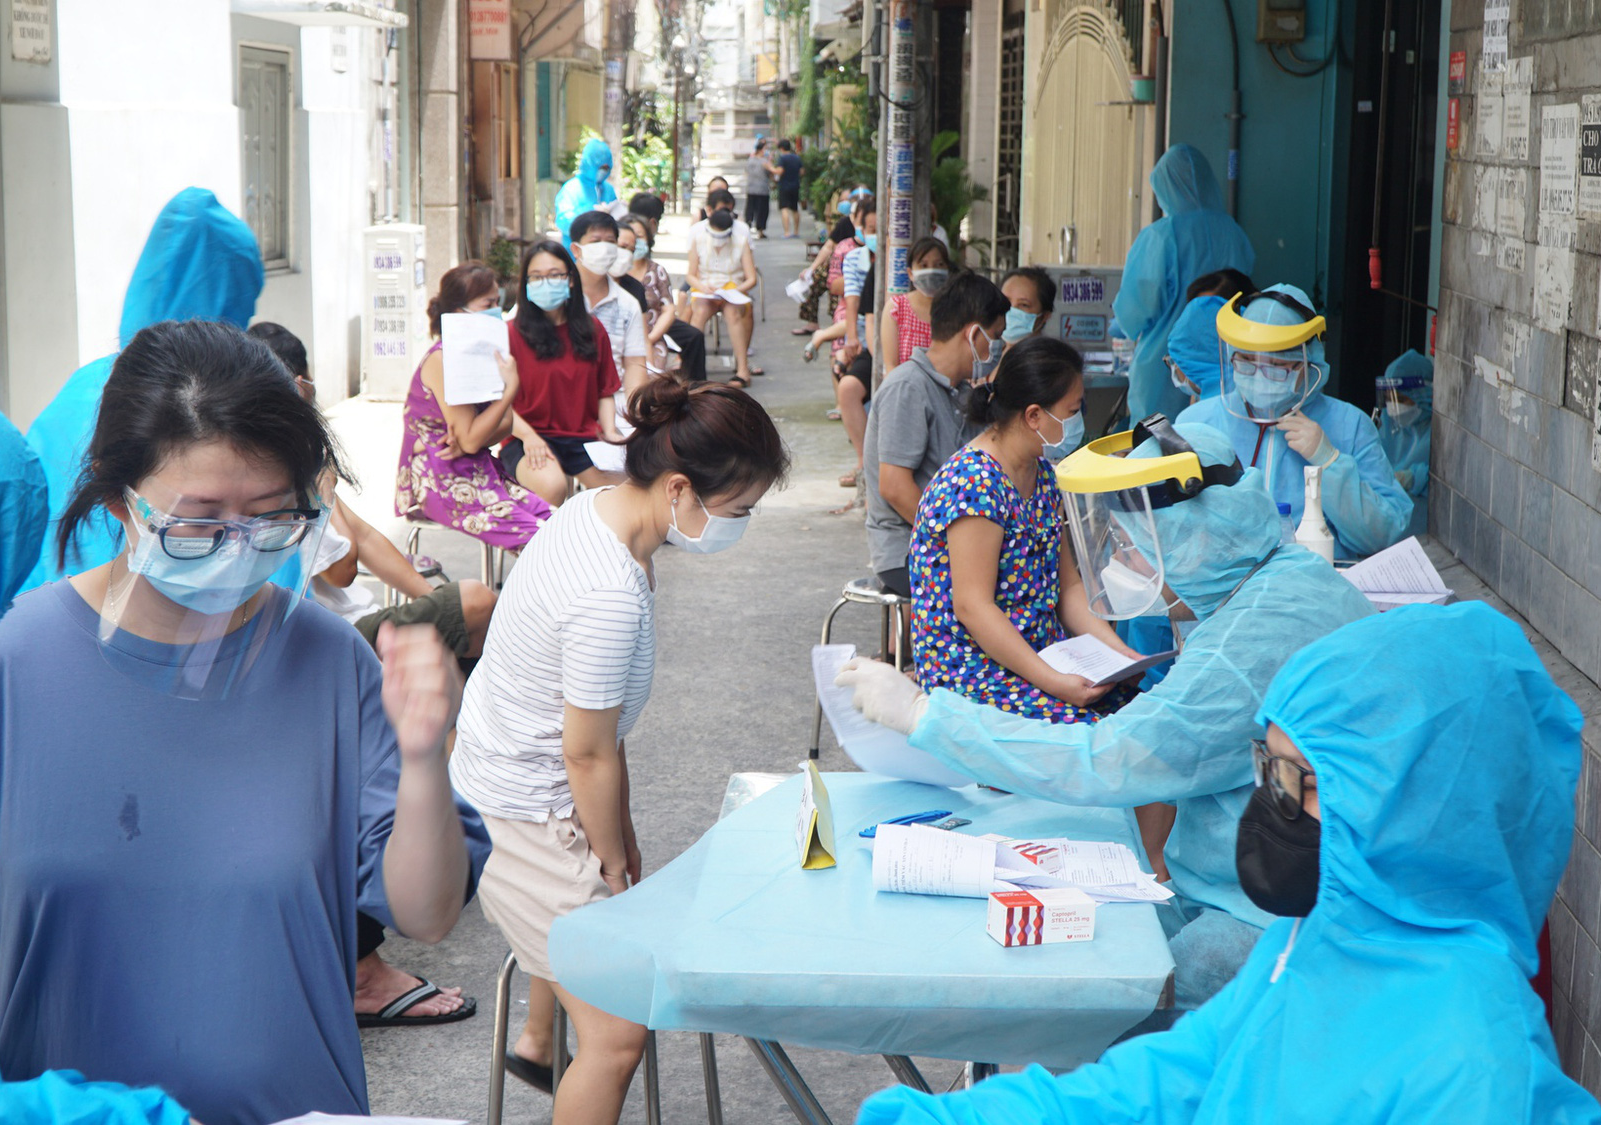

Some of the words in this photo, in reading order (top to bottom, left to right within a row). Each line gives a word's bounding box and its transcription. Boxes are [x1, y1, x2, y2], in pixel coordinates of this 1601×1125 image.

[1583, 130, 1599, 146] CHO
[1583, 153, 1597, 174] TRẢ
[1063, 283, 1078, 302] 0934
[1080, 283, 1090, 302] 386
[1092, 281, 1102, 301] 599
